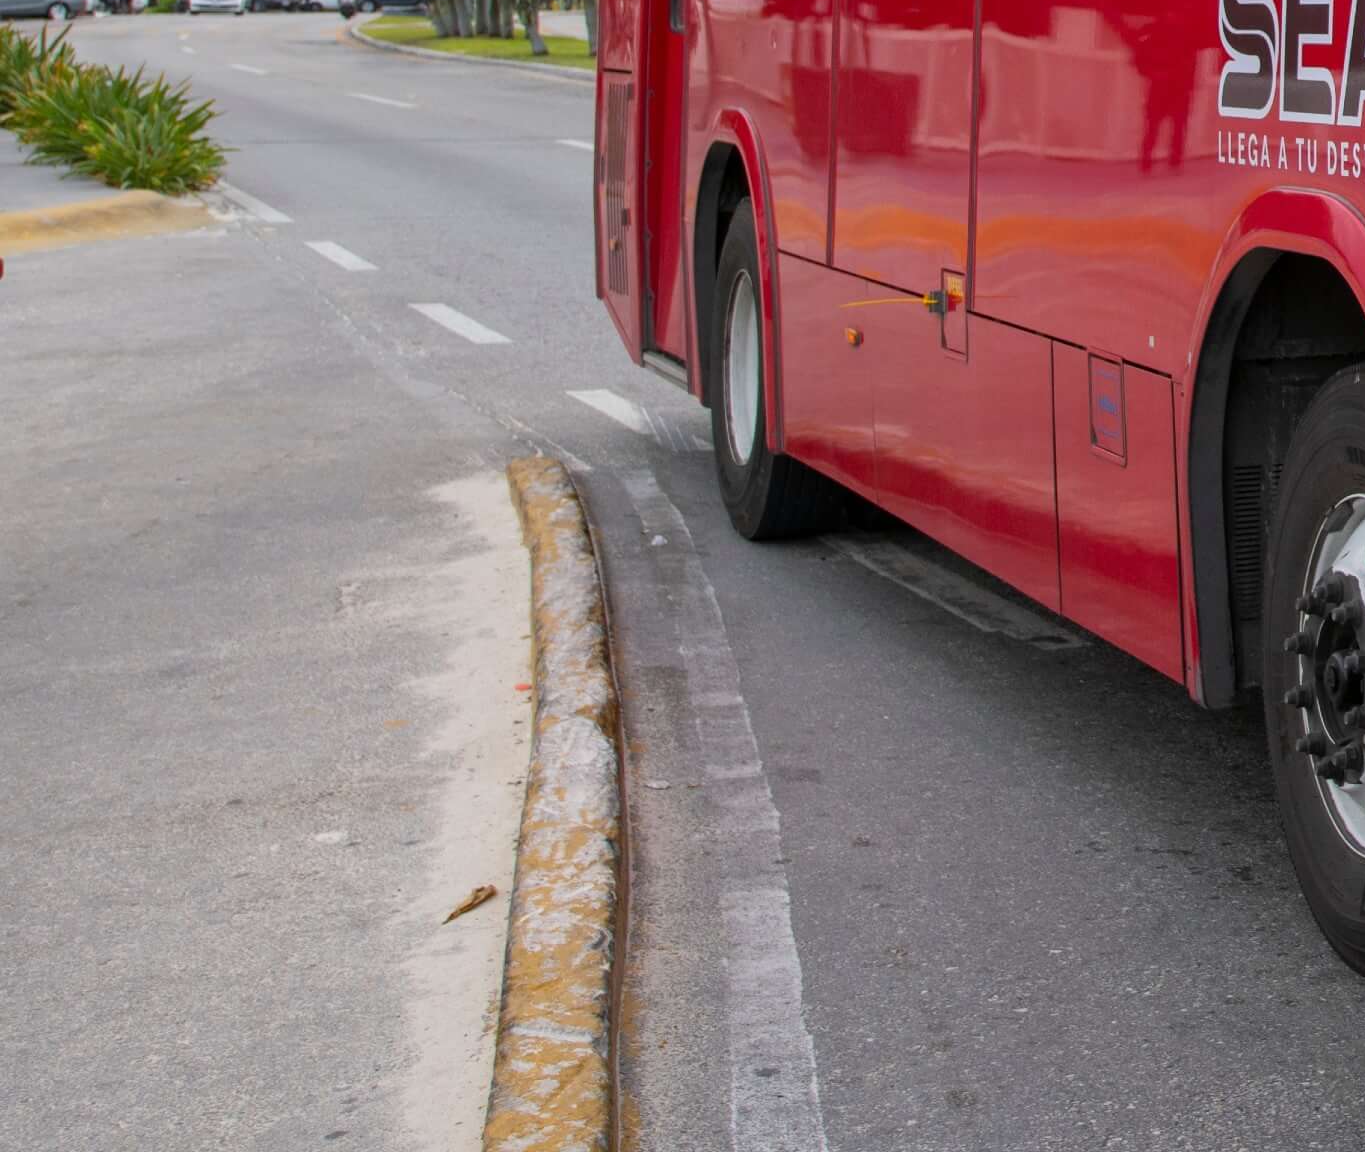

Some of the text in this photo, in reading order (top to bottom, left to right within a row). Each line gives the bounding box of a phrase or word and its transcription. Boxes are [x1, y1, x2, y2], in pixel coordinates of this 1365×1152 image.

[1217, 130, 1270, 168] LLEGA
[1278, 136, 1288, 170] A
[1295, 137, 1317, 174] TU
